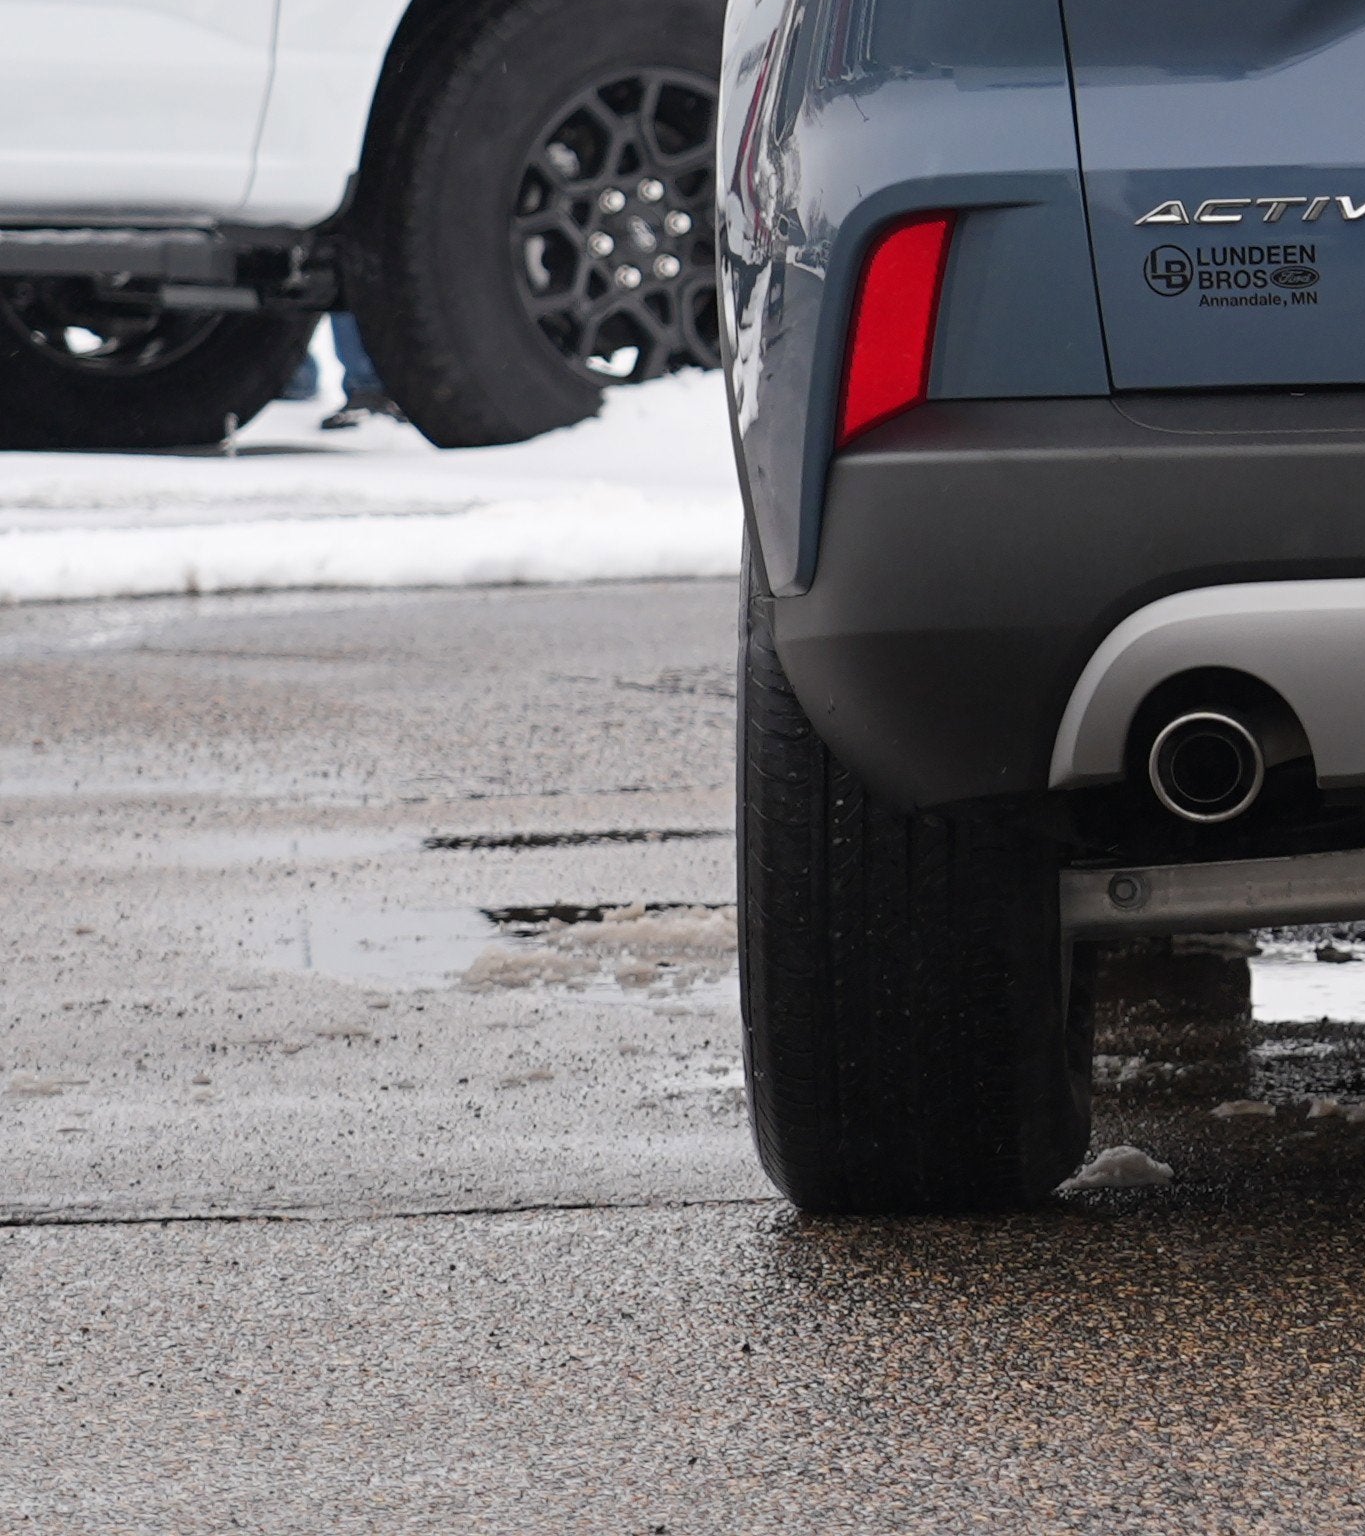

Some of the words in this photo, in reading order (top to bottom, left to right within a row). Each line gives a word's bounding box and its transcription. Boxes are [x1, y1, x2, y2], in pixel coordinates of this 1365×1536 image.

[1197, 245, 1316, 267] LUNDEEN
[1198, 270, 1268, 290] BROS
[1198, 294, 1288, 308] Annandale,
[1291, 292, 1318, 305] MN
